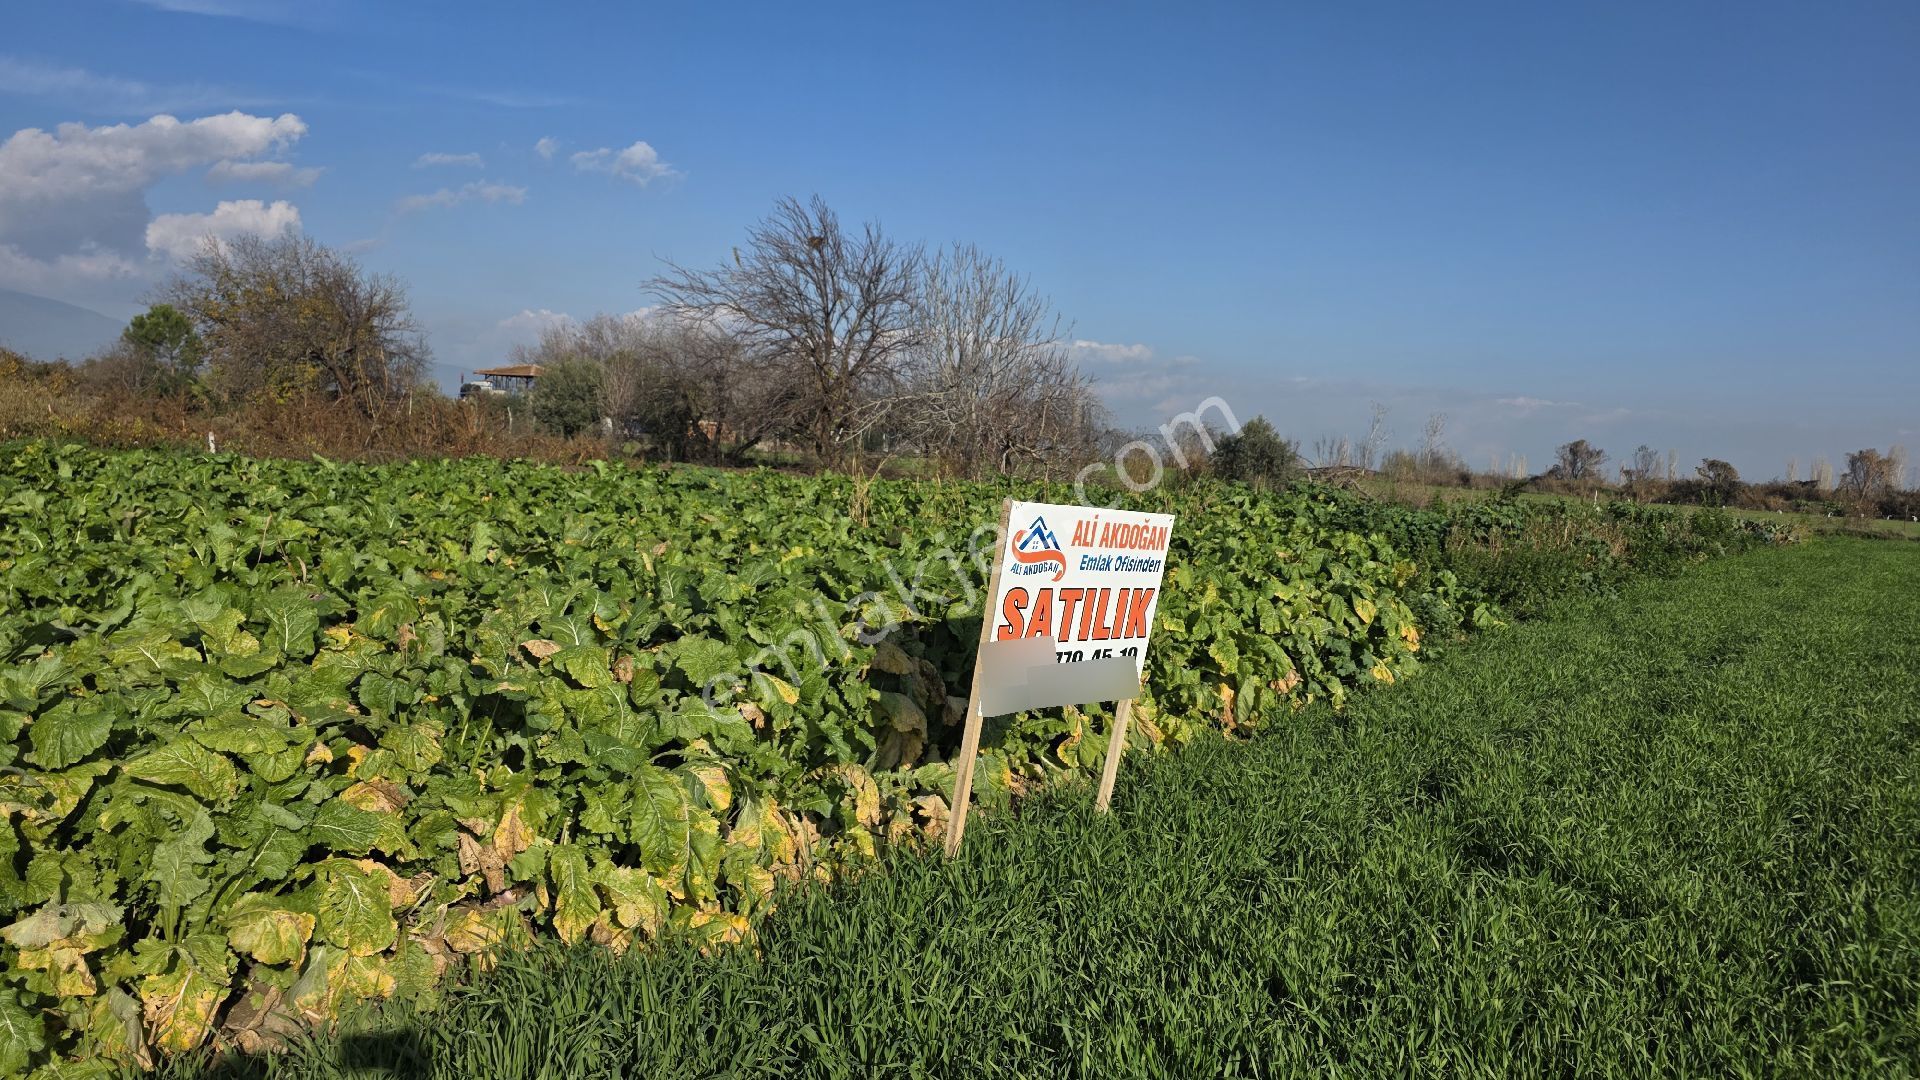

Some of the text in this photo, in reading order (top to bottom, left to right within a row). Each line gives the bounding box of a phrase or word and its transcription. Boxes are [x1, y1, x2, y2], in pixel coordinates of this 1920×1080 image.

[1071, 514, 1168, 551] ALİ AKDOĞAN
[1079, 554, 1162, 573] Emlak Ofisinden
[998, 587, 1155, 643] SATILIK
